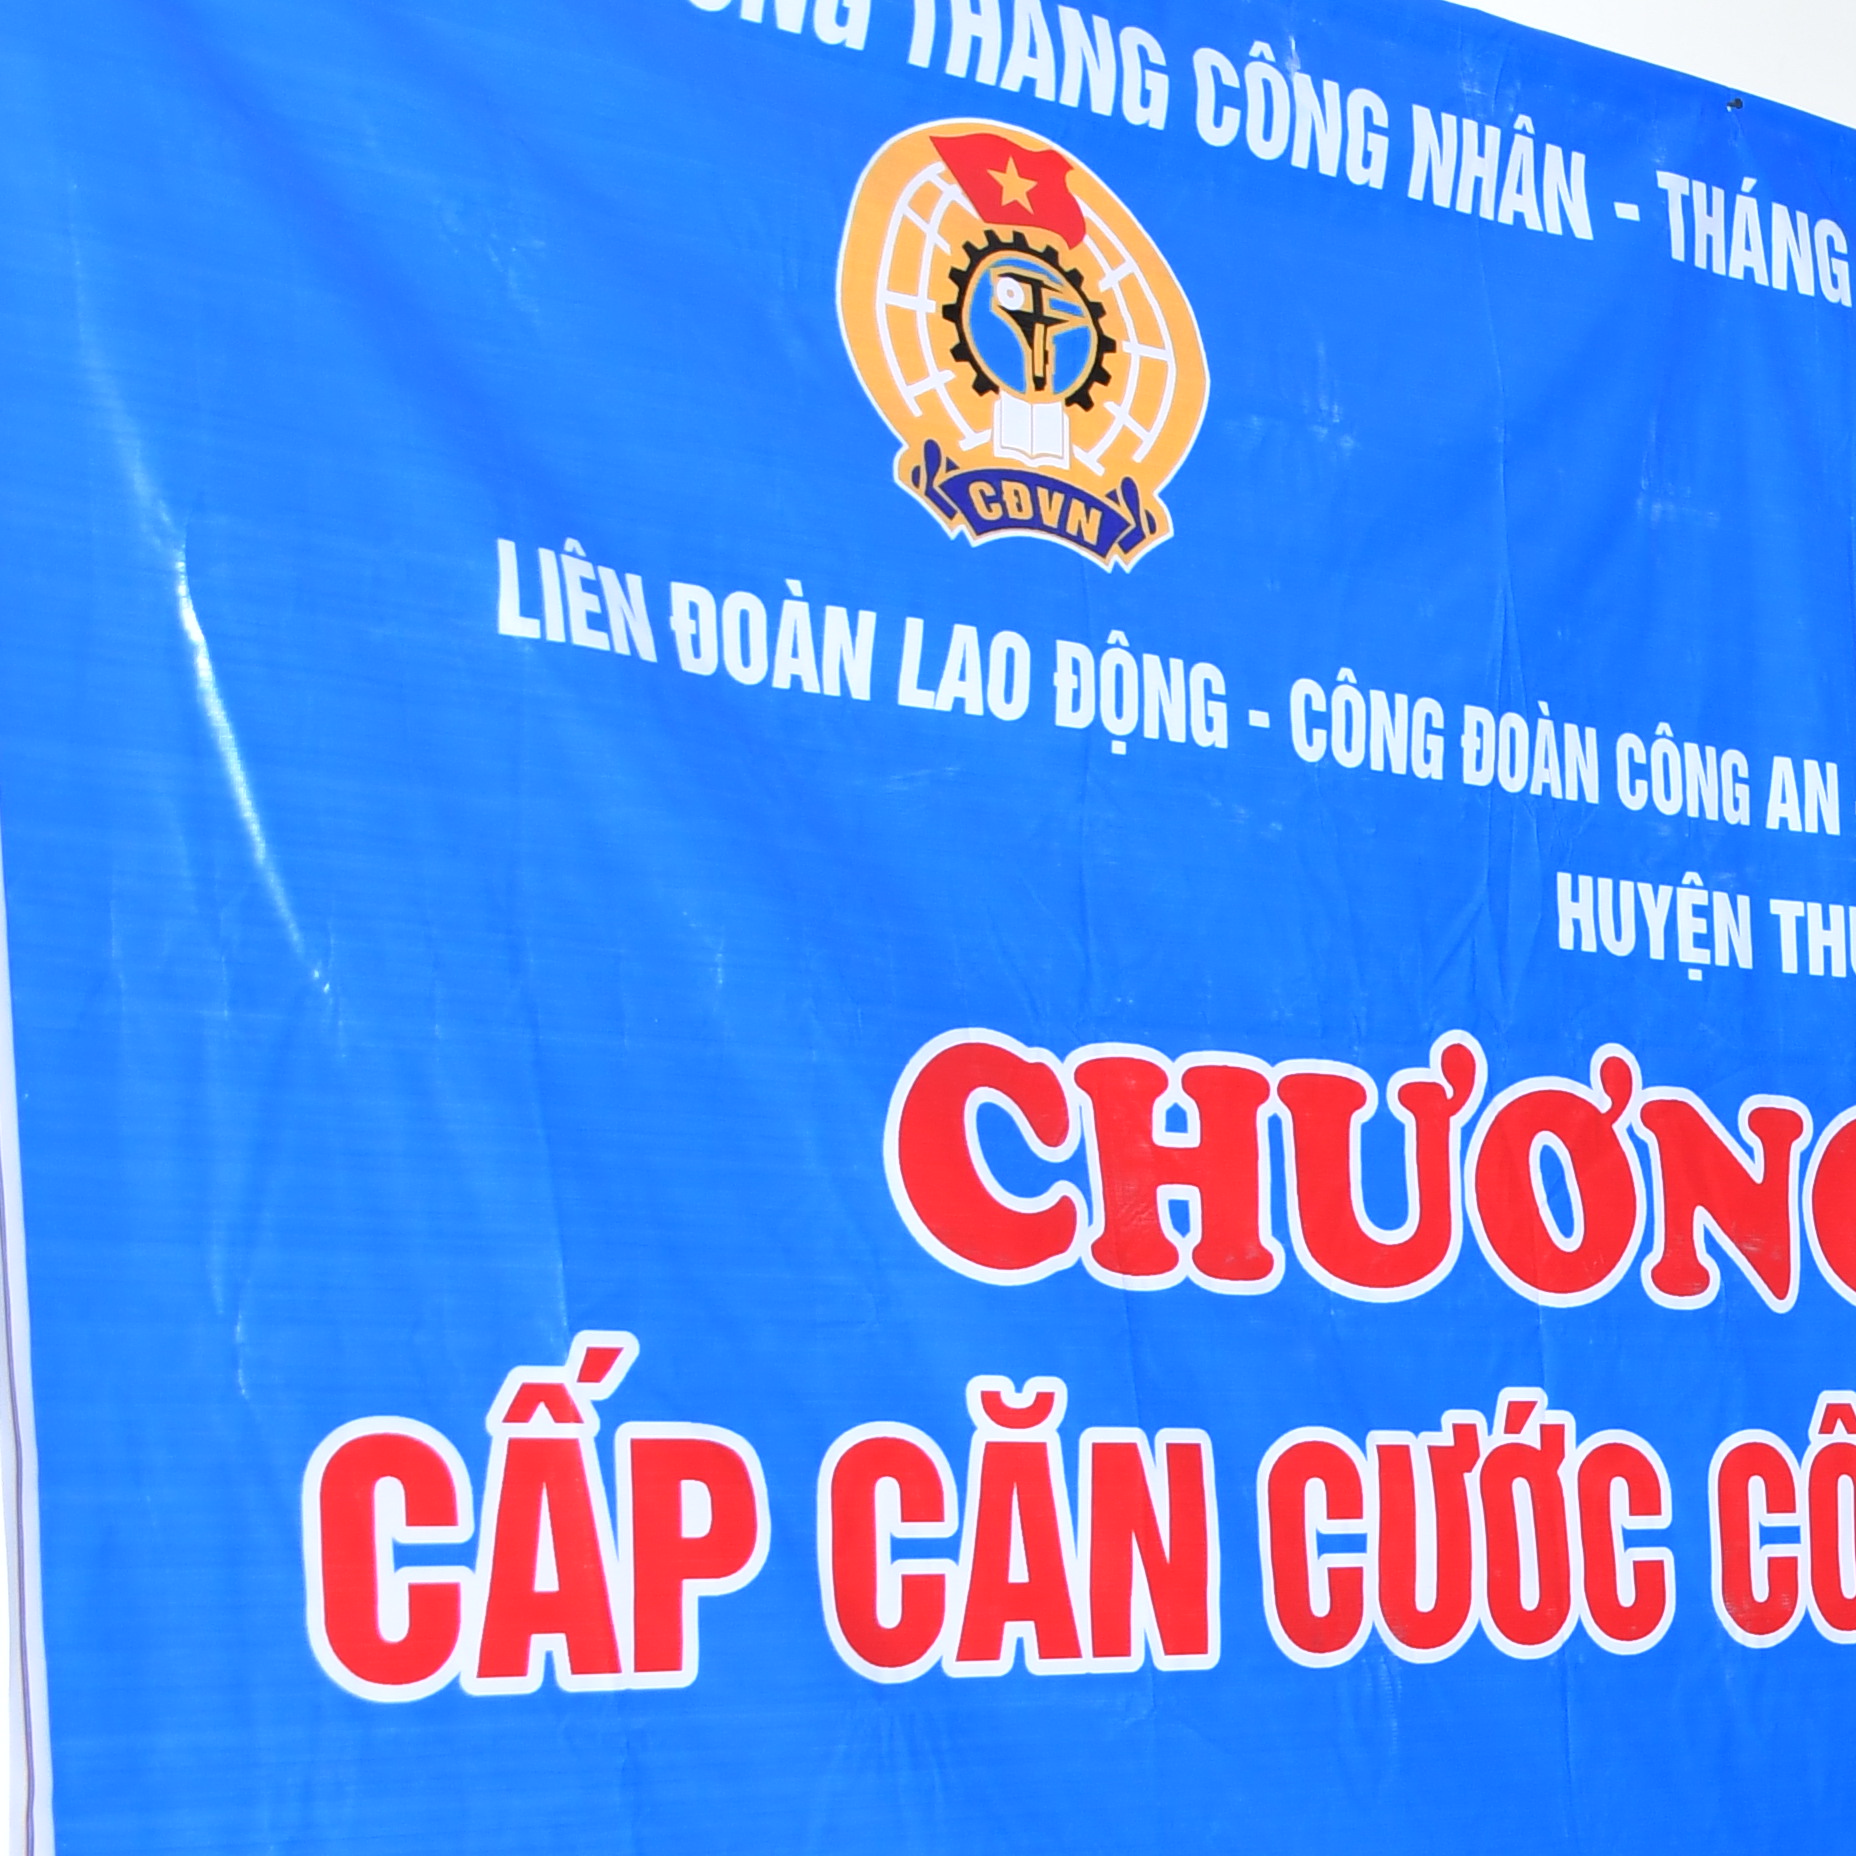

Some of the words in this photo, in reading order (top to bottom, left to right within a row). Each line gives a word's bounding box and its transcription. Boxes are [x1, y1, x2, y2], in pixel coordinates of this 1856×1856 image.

[1191, 39, 1390, 191] CÔNG
[1406, 103, 1595, 242] NHÂN
[1613, 200, 1641, 222] -
[1655, 169, 1853, 308] THÁNG
[967, 479, 1103, 546] CĐVN
[496, 536, 658, 664] LIÊN
[668, 577, 878, 702] ĐOÀN
[896, 615, 1032, 722] LAO
[1052, 628, 1229, 756] ĐỘNG
[1247, 708, 1271, 729] -
[1288, 666, 1446, 781] CÔNG
[1459, 699, 1600, 805] ĐOÀN
[1615, 720, 1751, 827] CÔNG
[1764, 754, 1842, 837] AN
[1555, 870, 1754, 982] HUYỆN
[313, 1340, 764, 1693] CẤP
[824, 1384, 1216, 1675] CĂN
[1260, 1394, 1673, 1661] CƯỚC
